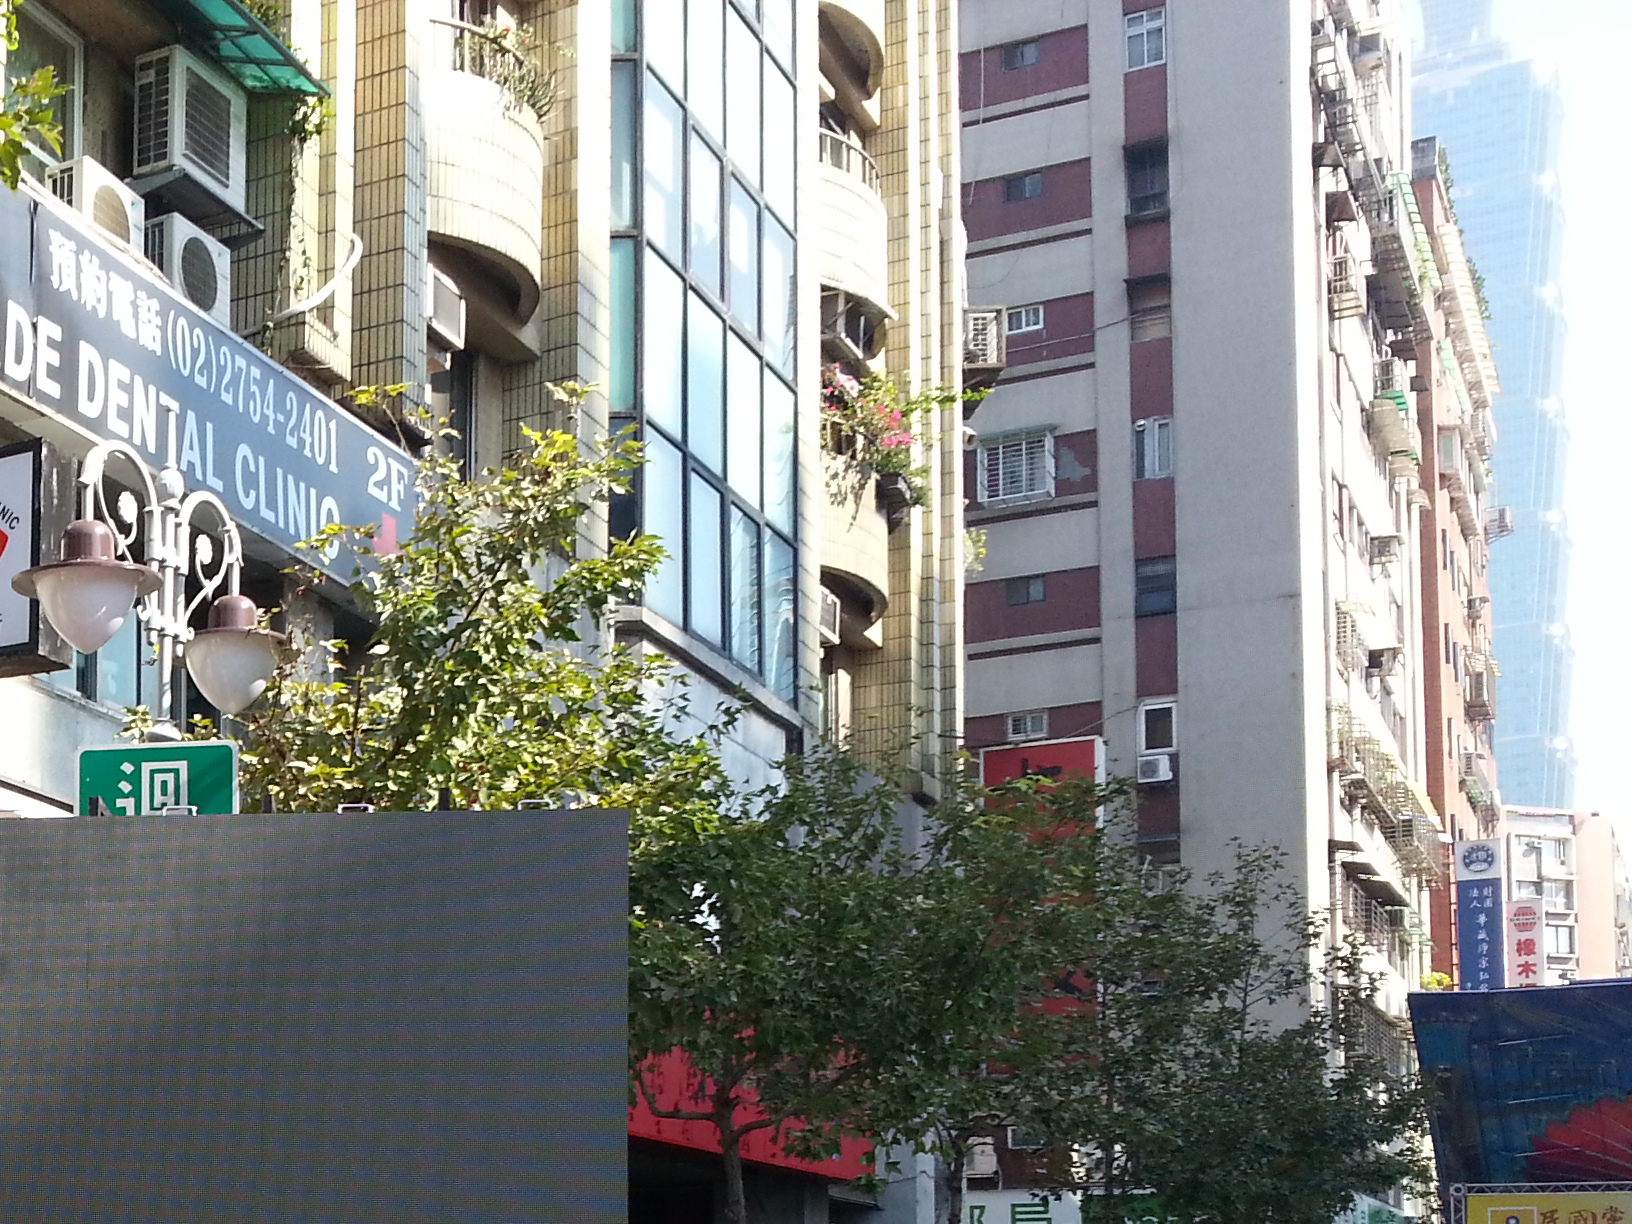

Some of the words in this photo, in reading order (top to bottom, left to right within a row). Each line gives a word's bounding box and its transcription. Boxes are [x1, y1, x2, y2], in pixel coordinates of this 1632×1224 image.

[49, 228, 162, 356] 預約電話
[167, 309, 340, 474] (02)2754-2401
[234, 442, 341, 559] CLINIC
[367, 445, 409, 512] 2F
